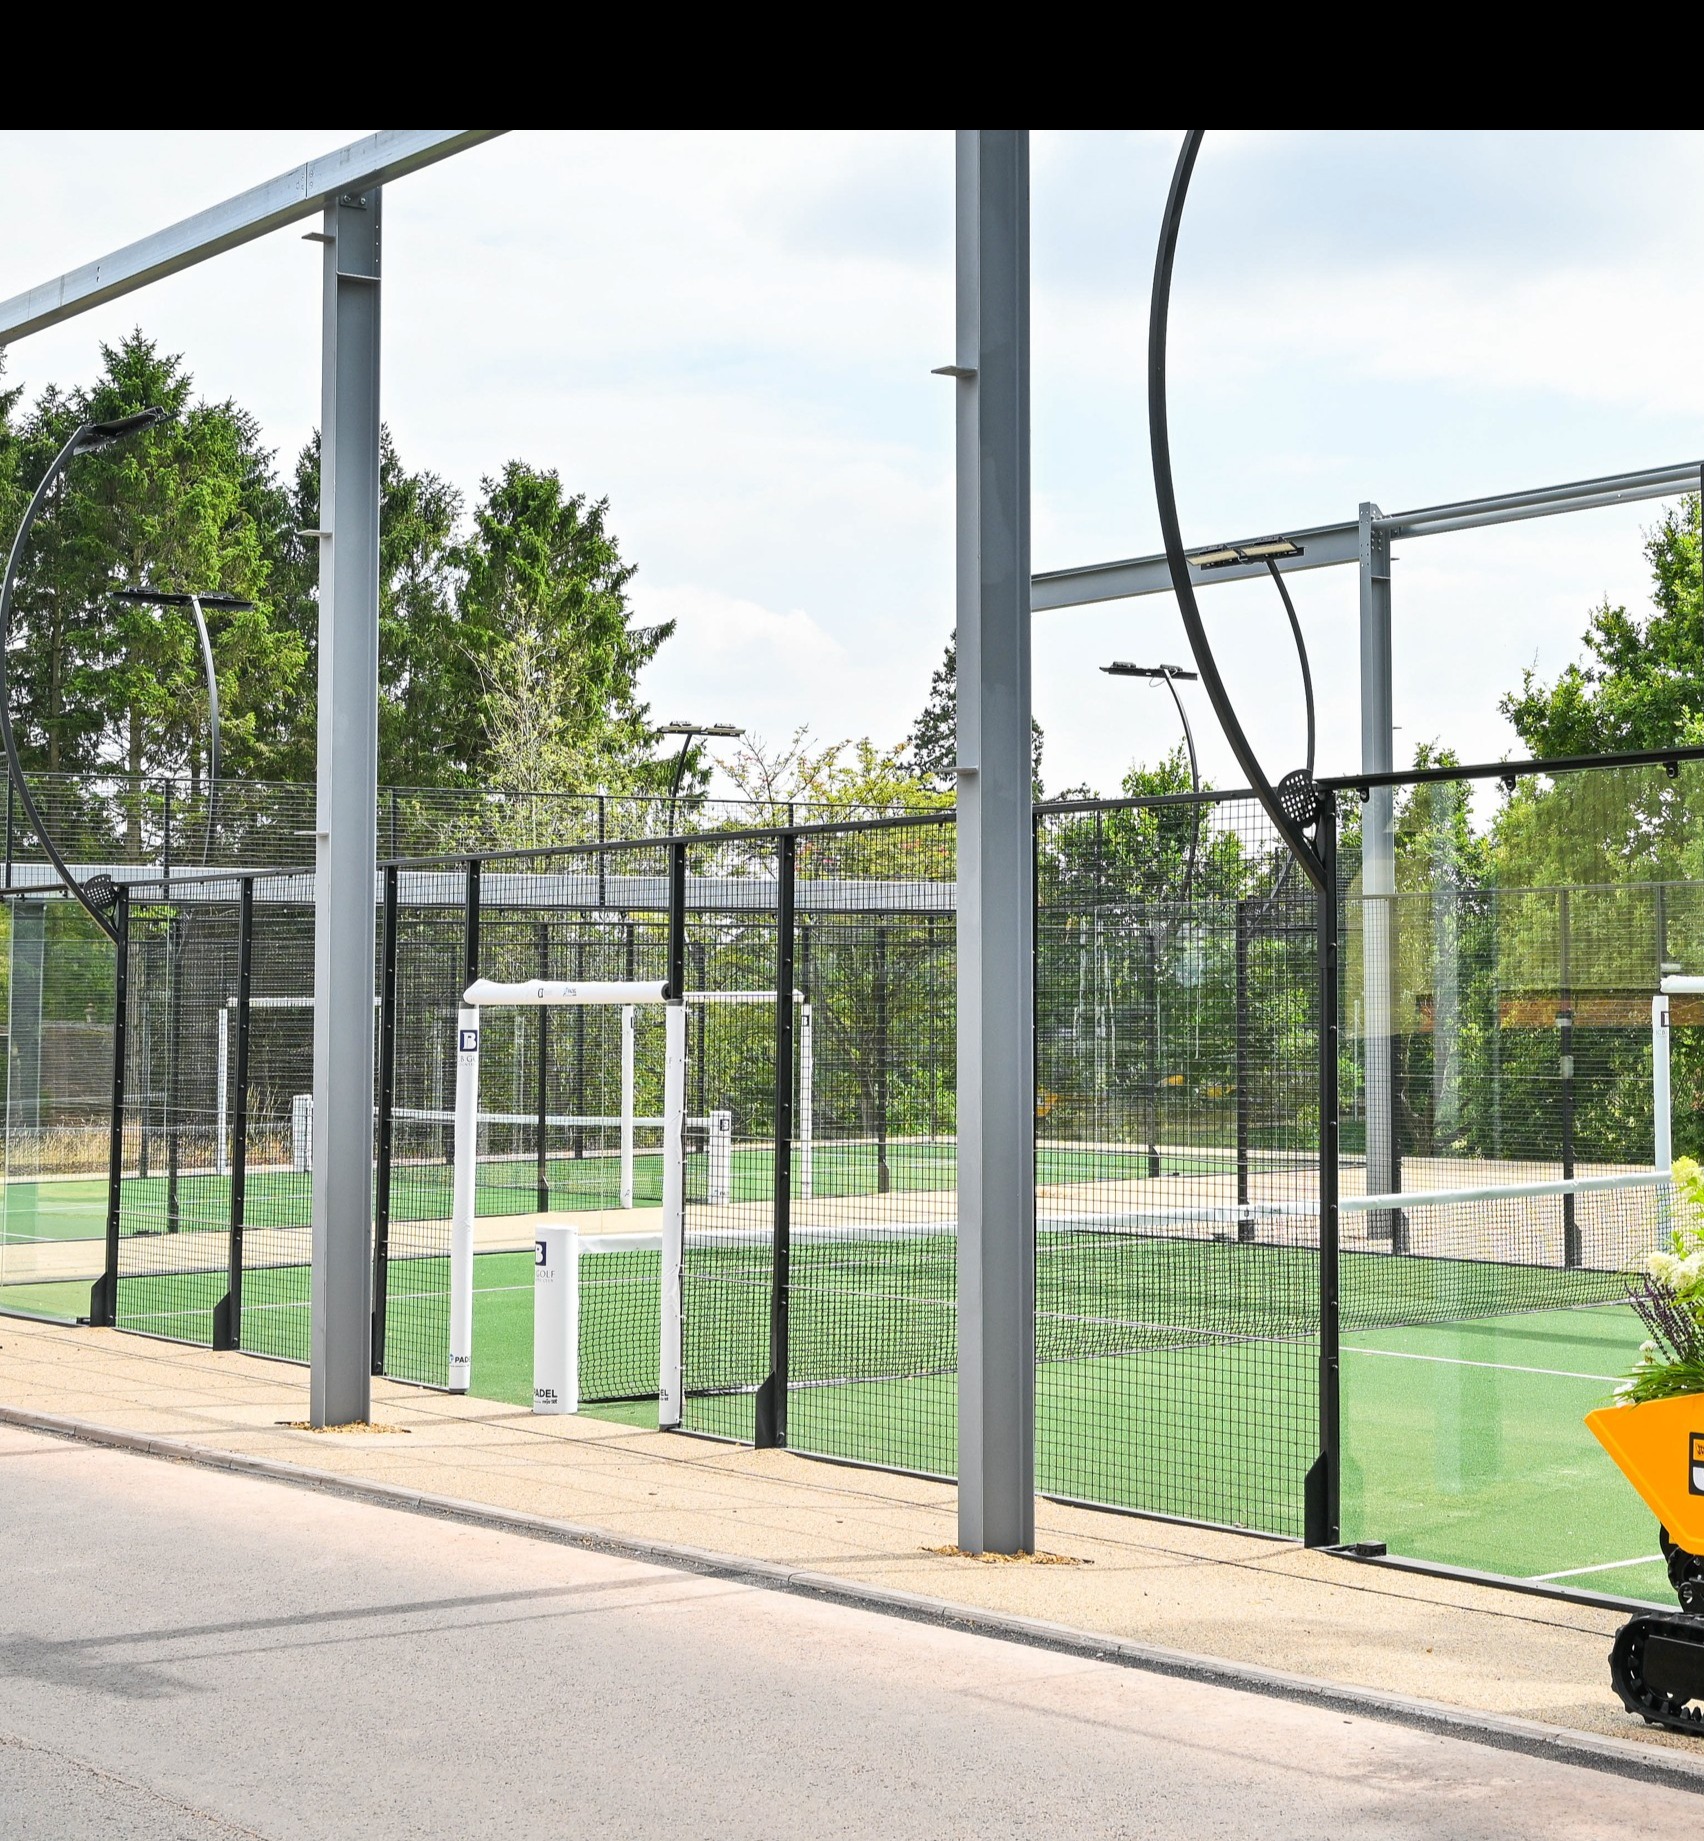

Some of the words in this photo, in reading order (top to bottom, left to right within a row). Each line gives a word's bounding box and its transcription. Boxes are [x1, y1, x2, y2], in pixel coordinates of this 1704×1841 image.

[462, 1031, 477, 1050] B
[454, 1356, 470, 1364] PAD
[533, 1388, 558, 1398] ADEL
